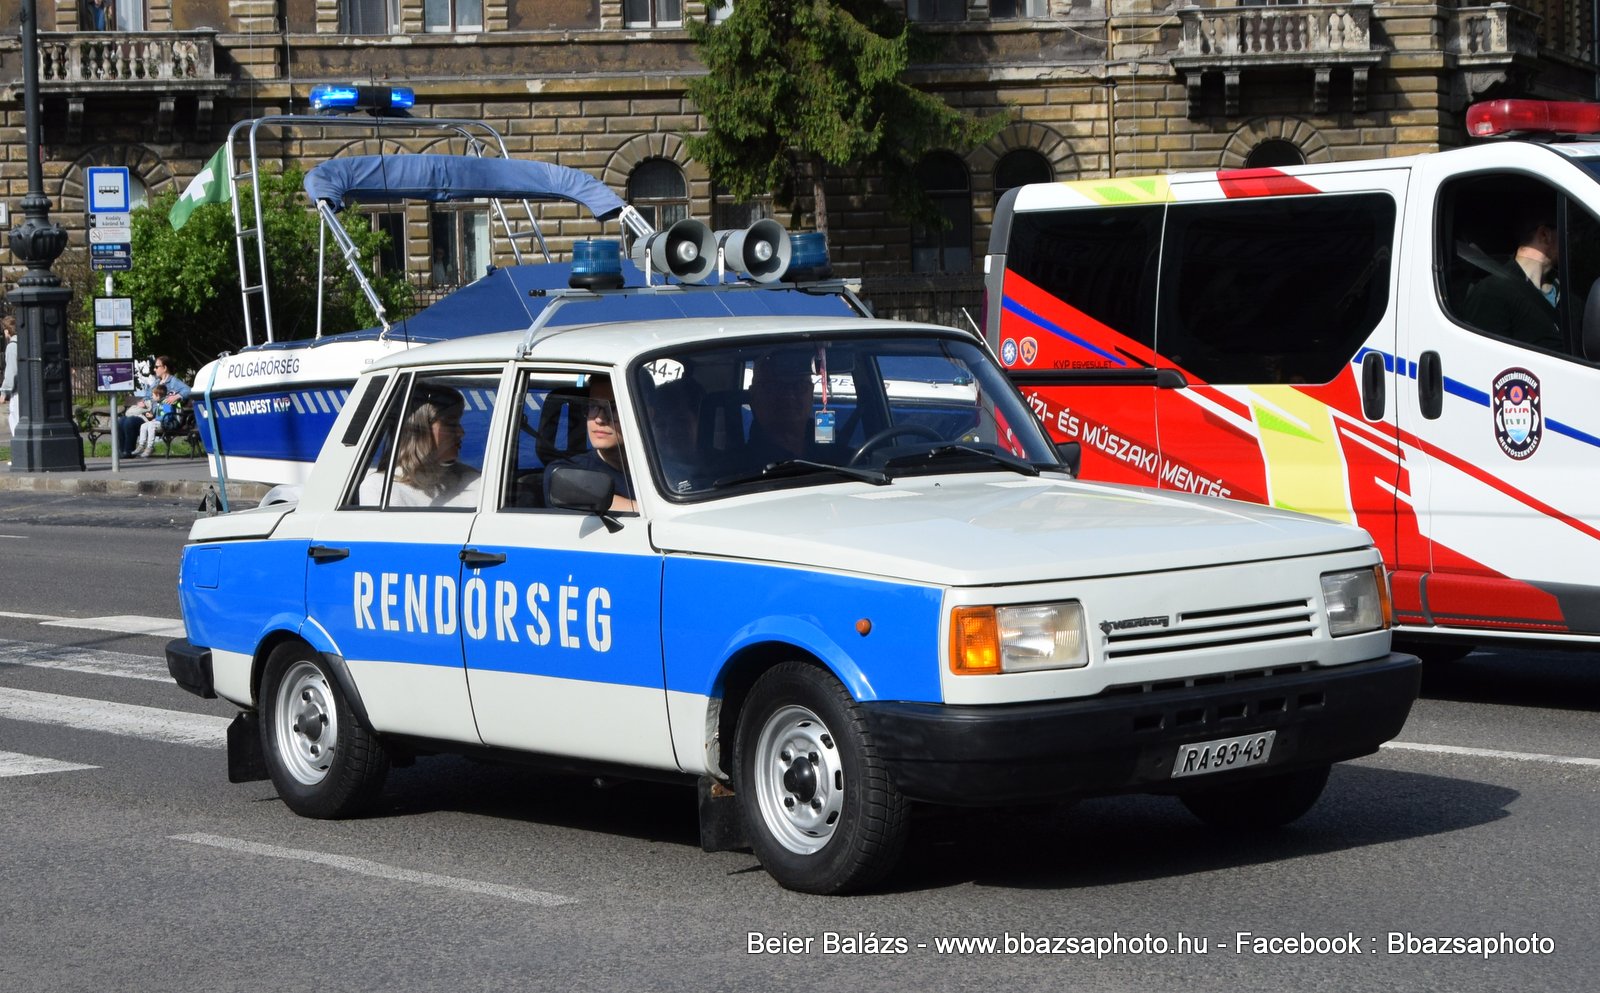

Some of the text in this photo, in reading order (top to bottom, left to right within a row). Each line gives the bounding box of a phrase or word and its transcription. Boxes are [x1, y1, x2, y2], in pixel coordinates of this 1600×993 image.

[228, 355, 299, 379] POLGÁRŐRSÉG
[1053, 360, 1069, 370] KVP
[229, 397, 291, 416] BUDAPEST KVP
[1058, 408, 1079, 437] ÉS
[1083, 422, 1158, 473] MŰSZAKI
[353, 568, 612, 653] RENDŐRSÉG
